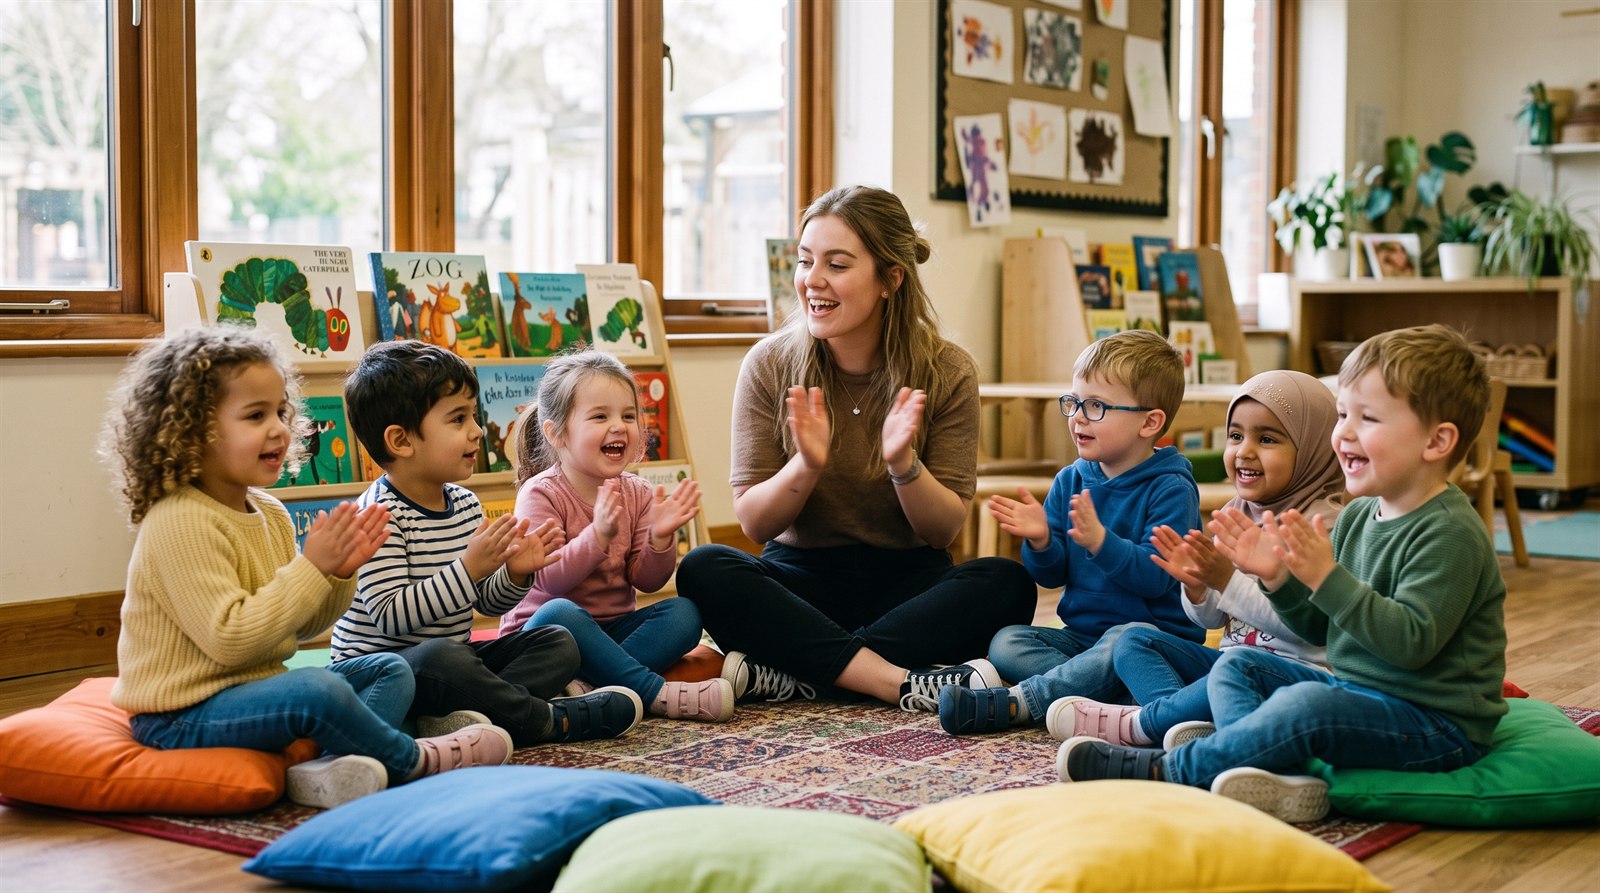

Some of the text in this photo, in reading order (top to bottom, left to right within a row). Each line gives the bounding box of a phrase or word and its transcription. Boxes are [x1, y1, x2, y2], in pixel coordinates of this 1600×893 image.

[329, 250, 346, 258] VERY
[303, 265, 350, 273] CATERPILLAR
[408, 257, 463, 280] ZOG
